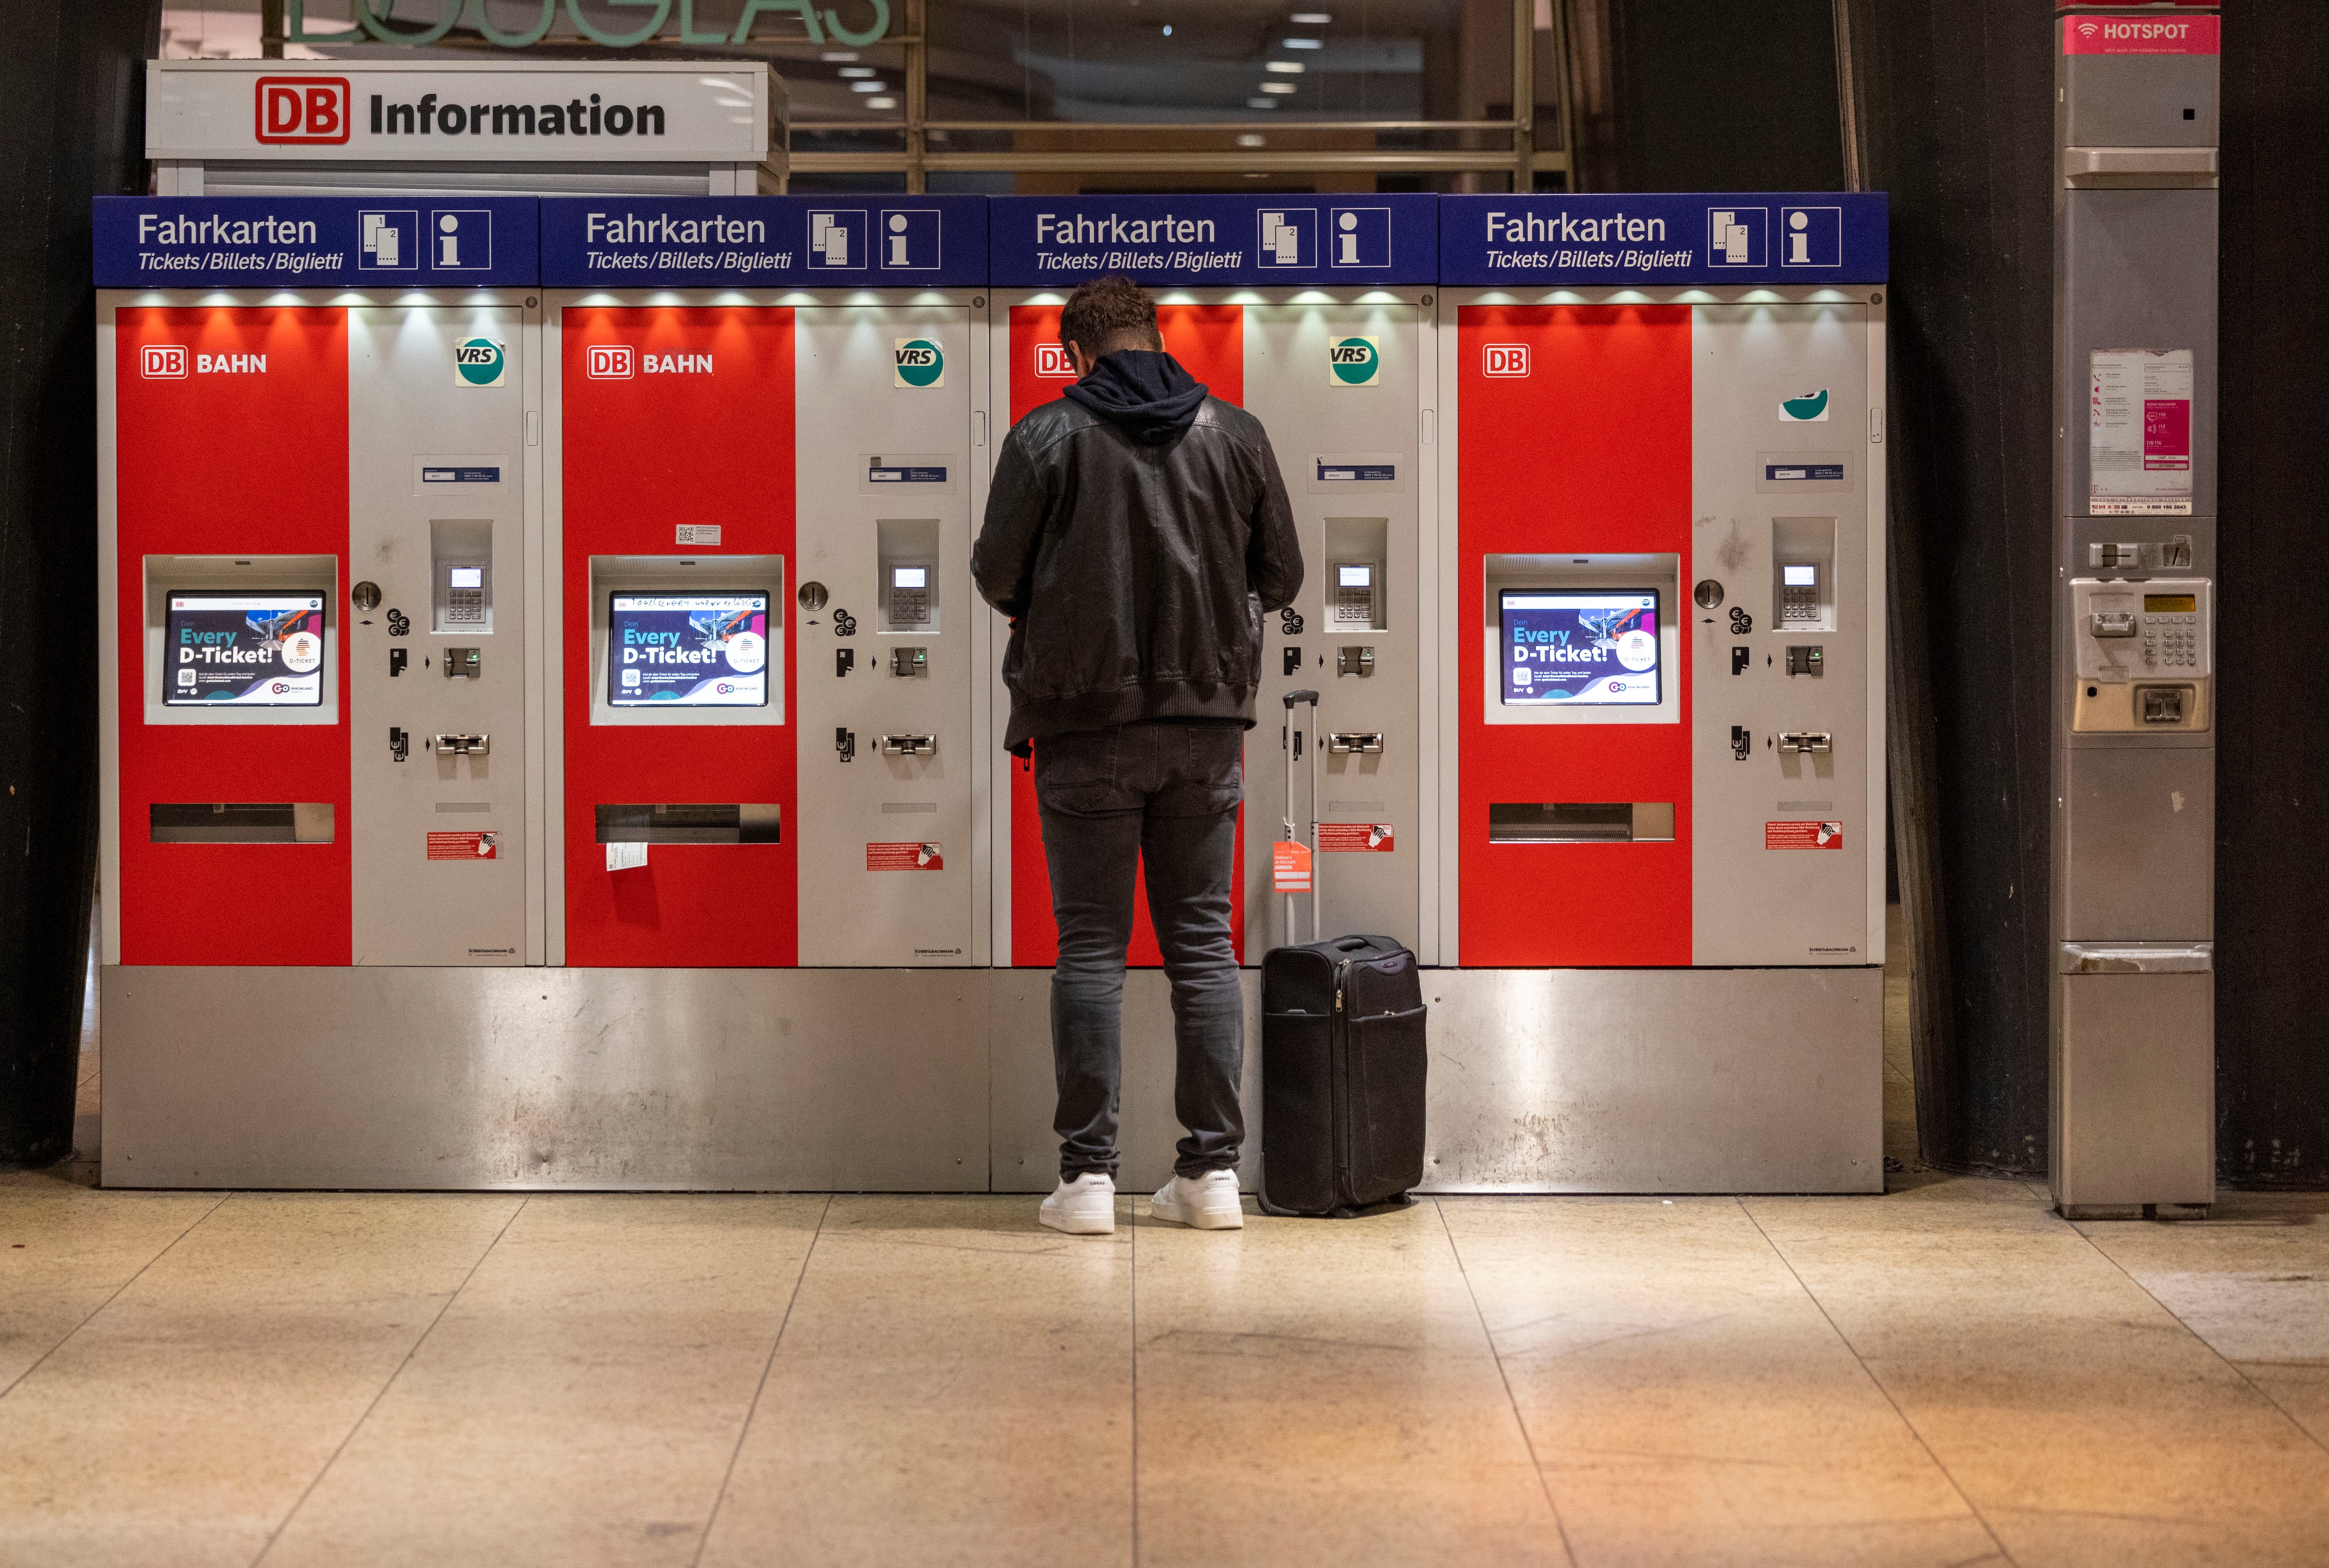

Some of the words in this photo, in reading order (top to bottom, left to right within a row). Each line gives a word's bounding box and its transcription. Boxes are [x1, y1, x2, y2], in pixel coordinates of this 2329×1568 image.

[2104, 24, 2188, 39] HOTSPOT
[268, 88, 339, 134] DB
[370, 94, 666, 136] Information
[139, 214, 316, 244] Fahrkarten
[587, 213, 765, 243] Fahrkarten
[1037, 213, 1215, 243] Fahrkarten
[1487, 212, 1665, 242] Fahrkarten
[149, 352, 182, 372] DB
[197, 354, 266, 373] BAHN
[456, 348, 492, 363] VRS
[594, 353, 628, 372] DB
[644, 354, 713, 373] BAHN
[895, 350, 931, 365] VRS
[1330, 348, 1367, 362] VRS
[1490, 351, 1523, 371] DB
[632, 597, 689, 607] Touchscreen
[180, 629, 237, 648] Every
[624, 629, 681, 648] Every
[1513, 627, 1570, 646] Every
[179, 647, 272, 663] D-Ticket!
[623, 647, 716, 663] D-Ticket!
[1513, 645, 1607, 662] D-Ticket!
[272, 683, 290, 694] GO
[717, 683, 735, 694] GO
[1608, 681, 1627, 693] GO
